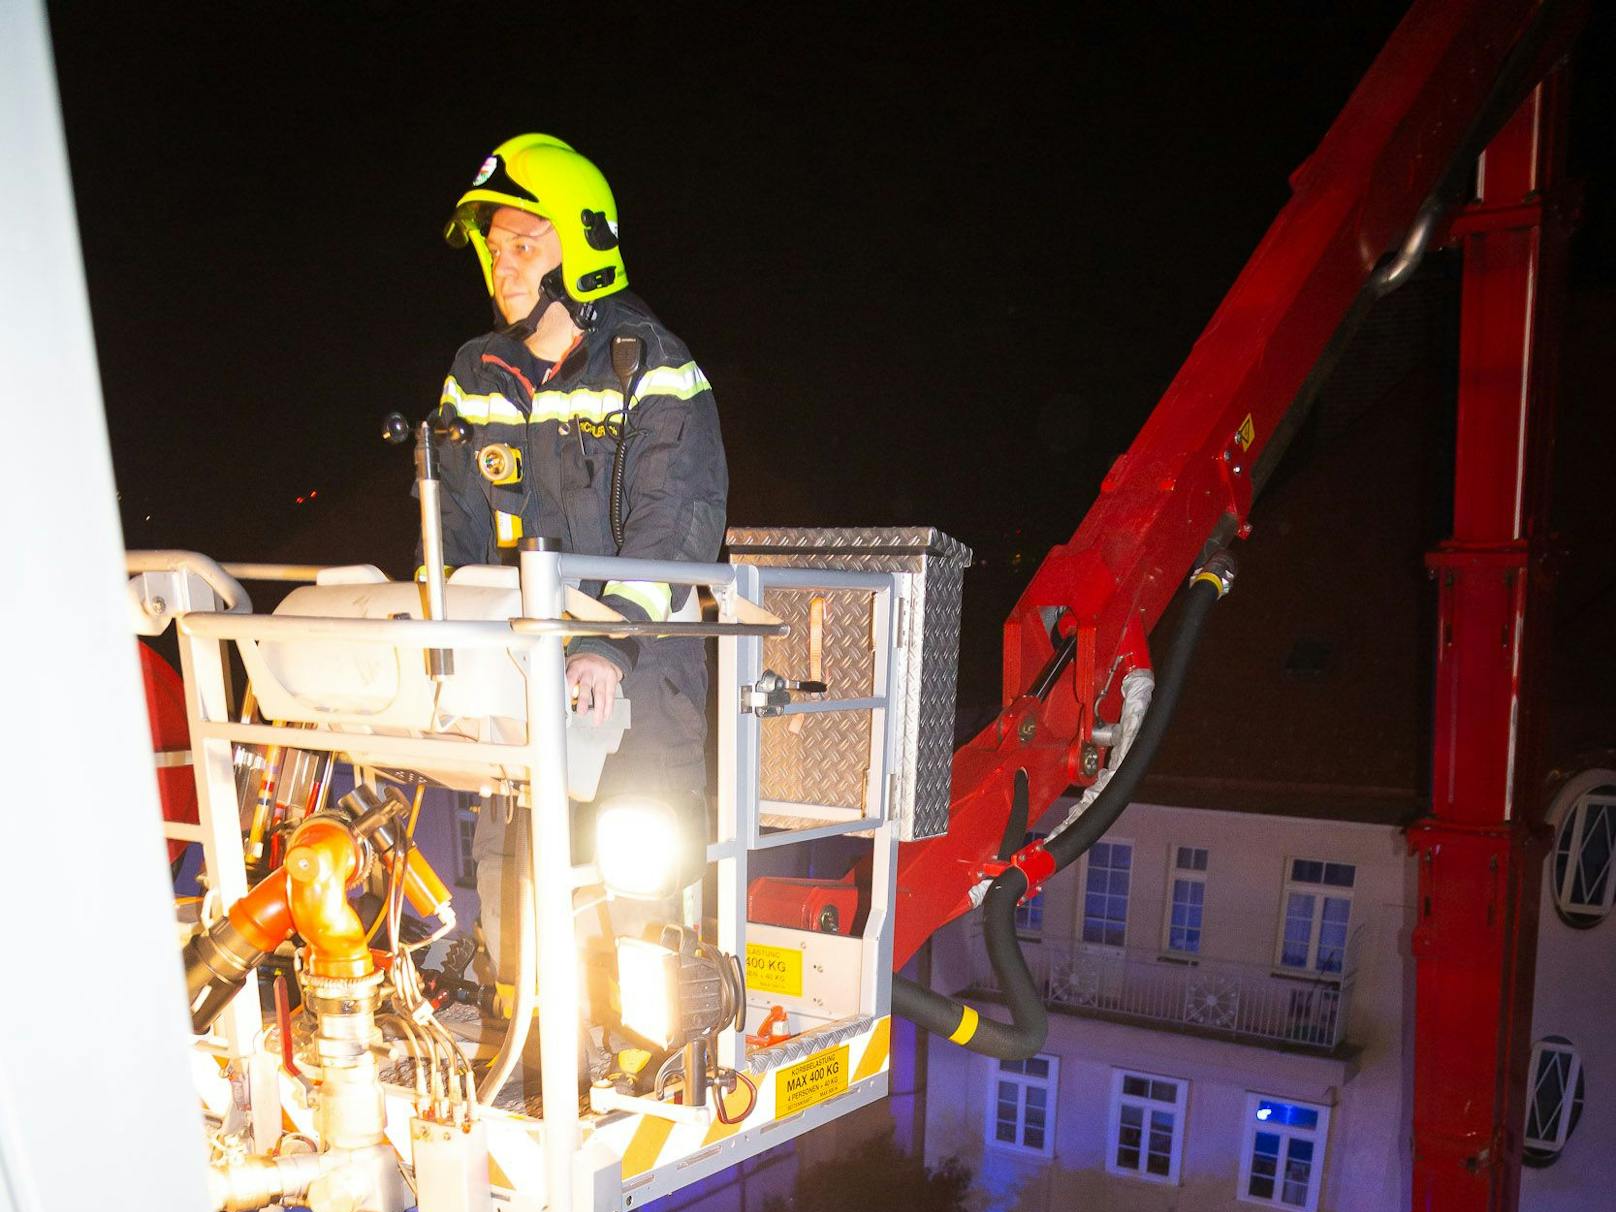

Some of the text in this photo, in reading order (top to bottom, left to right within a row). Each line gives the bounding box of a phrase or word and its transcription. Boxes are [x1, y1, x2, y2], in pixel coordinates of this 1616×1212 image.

[746, 957, 765, 969] 400
[768, 959, 786, 973] KG
[787, 1061, 839, 1093] MAX 400 KG
